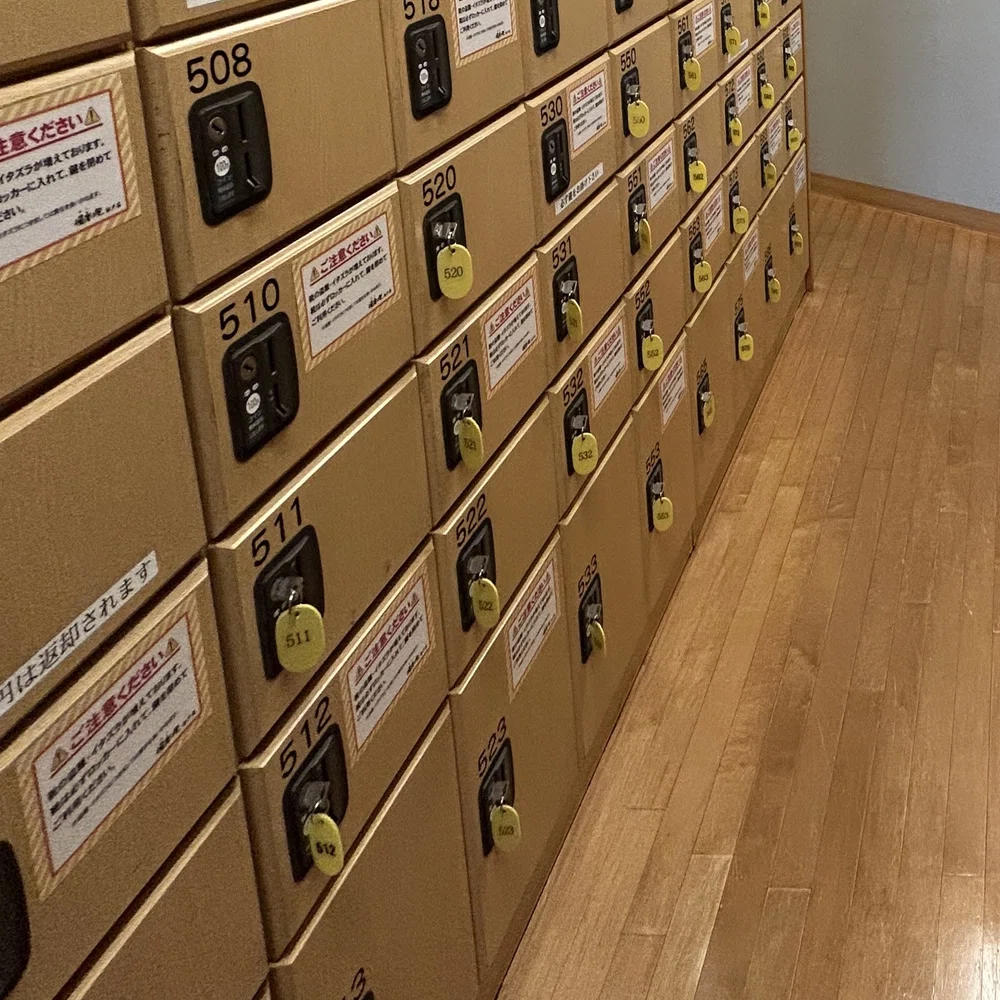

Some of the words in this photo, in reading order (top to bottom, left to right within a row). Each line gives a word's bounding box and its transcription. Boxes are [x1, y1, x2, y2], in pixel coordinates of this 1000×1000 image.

[677, 16, 690, 35] 561
[187, 43, 252, 93] 508
[620, 48, 637, 71] 550
[540, 96, 562, 126] 530
[683, 117, 695, 139] 562
[422, 165, 456, 206] 520
[628, 167, 642, 193] 551
[320, 232, 374, 275] ご注意ください
[552, 235, 572, 268] 531
[444, 266, 463, 278] 520
[220, 278, 279, 340] 510
[635, 280, 650, 309] 552
[440, 335, 470, 380] 521
[562, 367, 583, 406] 532
[578, 450, 593, 460] 532
[646, 442, 660, 475] 553
[252, 497, 302, 567] 511
[456, 493, 487, 547] 522
[578, 554, 597, 598] 533
[286, 630, 310, 648] 511
[280, 697, 331, 779] 512
[478, 716, 507, 777] 523
